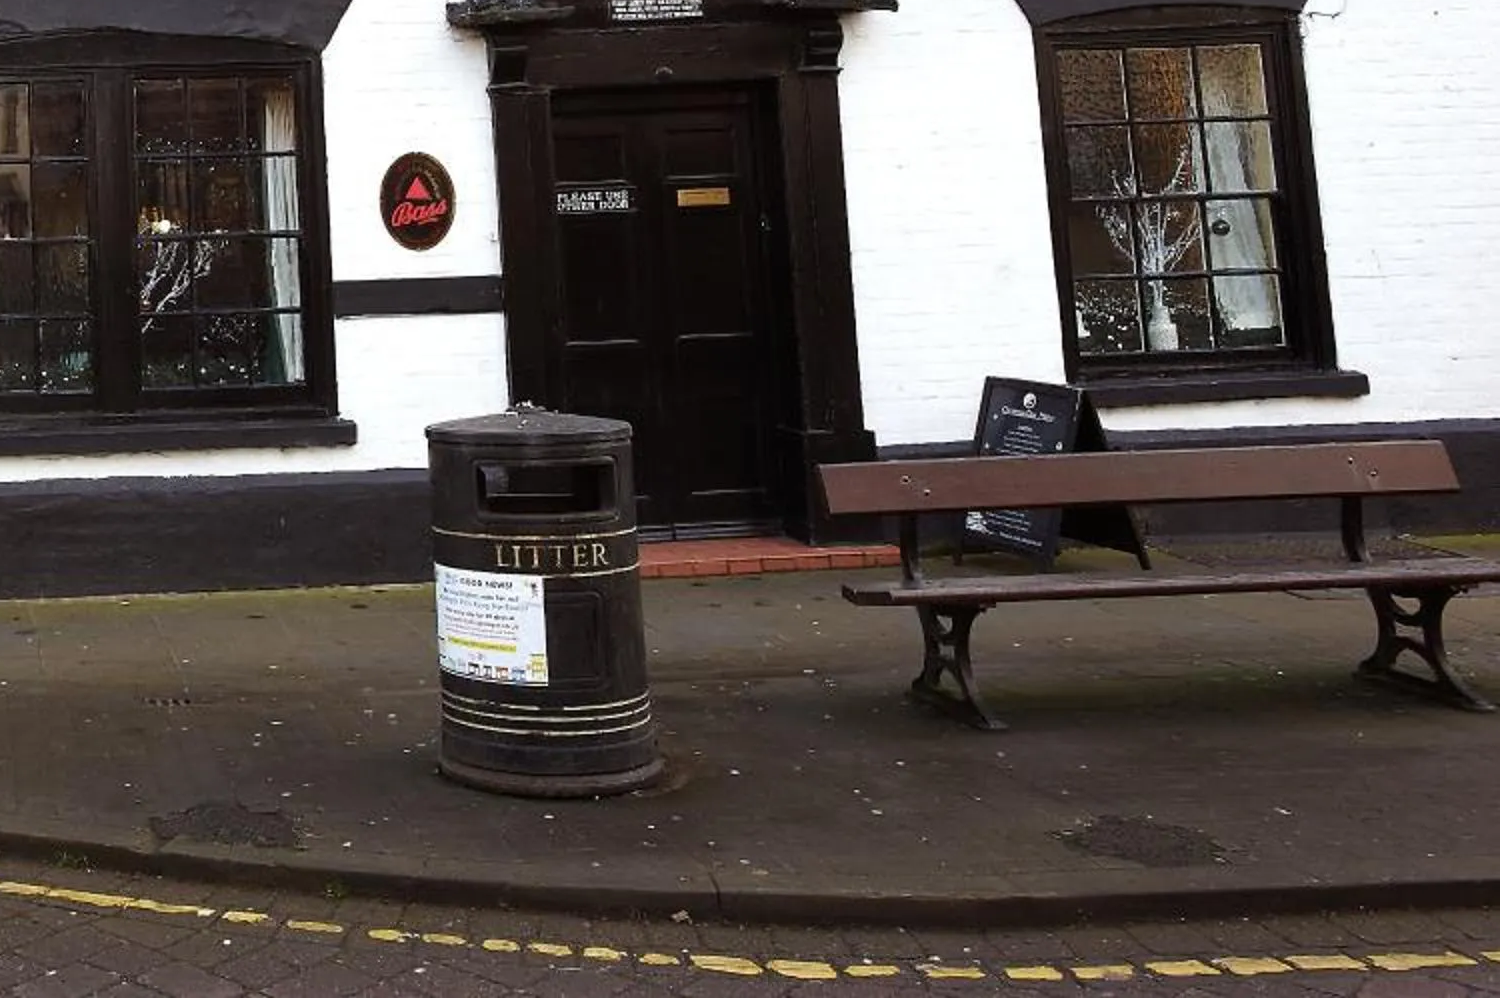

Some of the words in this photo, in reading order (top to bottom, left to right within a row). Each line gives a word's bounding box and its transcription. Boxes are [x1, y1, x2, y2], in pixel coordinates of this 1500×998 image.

[557, 191, 603, 203] PLEASE
[605, 190, 629, 201] USE
[557, 201, 595, 211] OTHER
[599, 200, 629, 210] DOOR
[391, 198, 448, 227] Bass
[495, 543, 610, 569] LITTER
